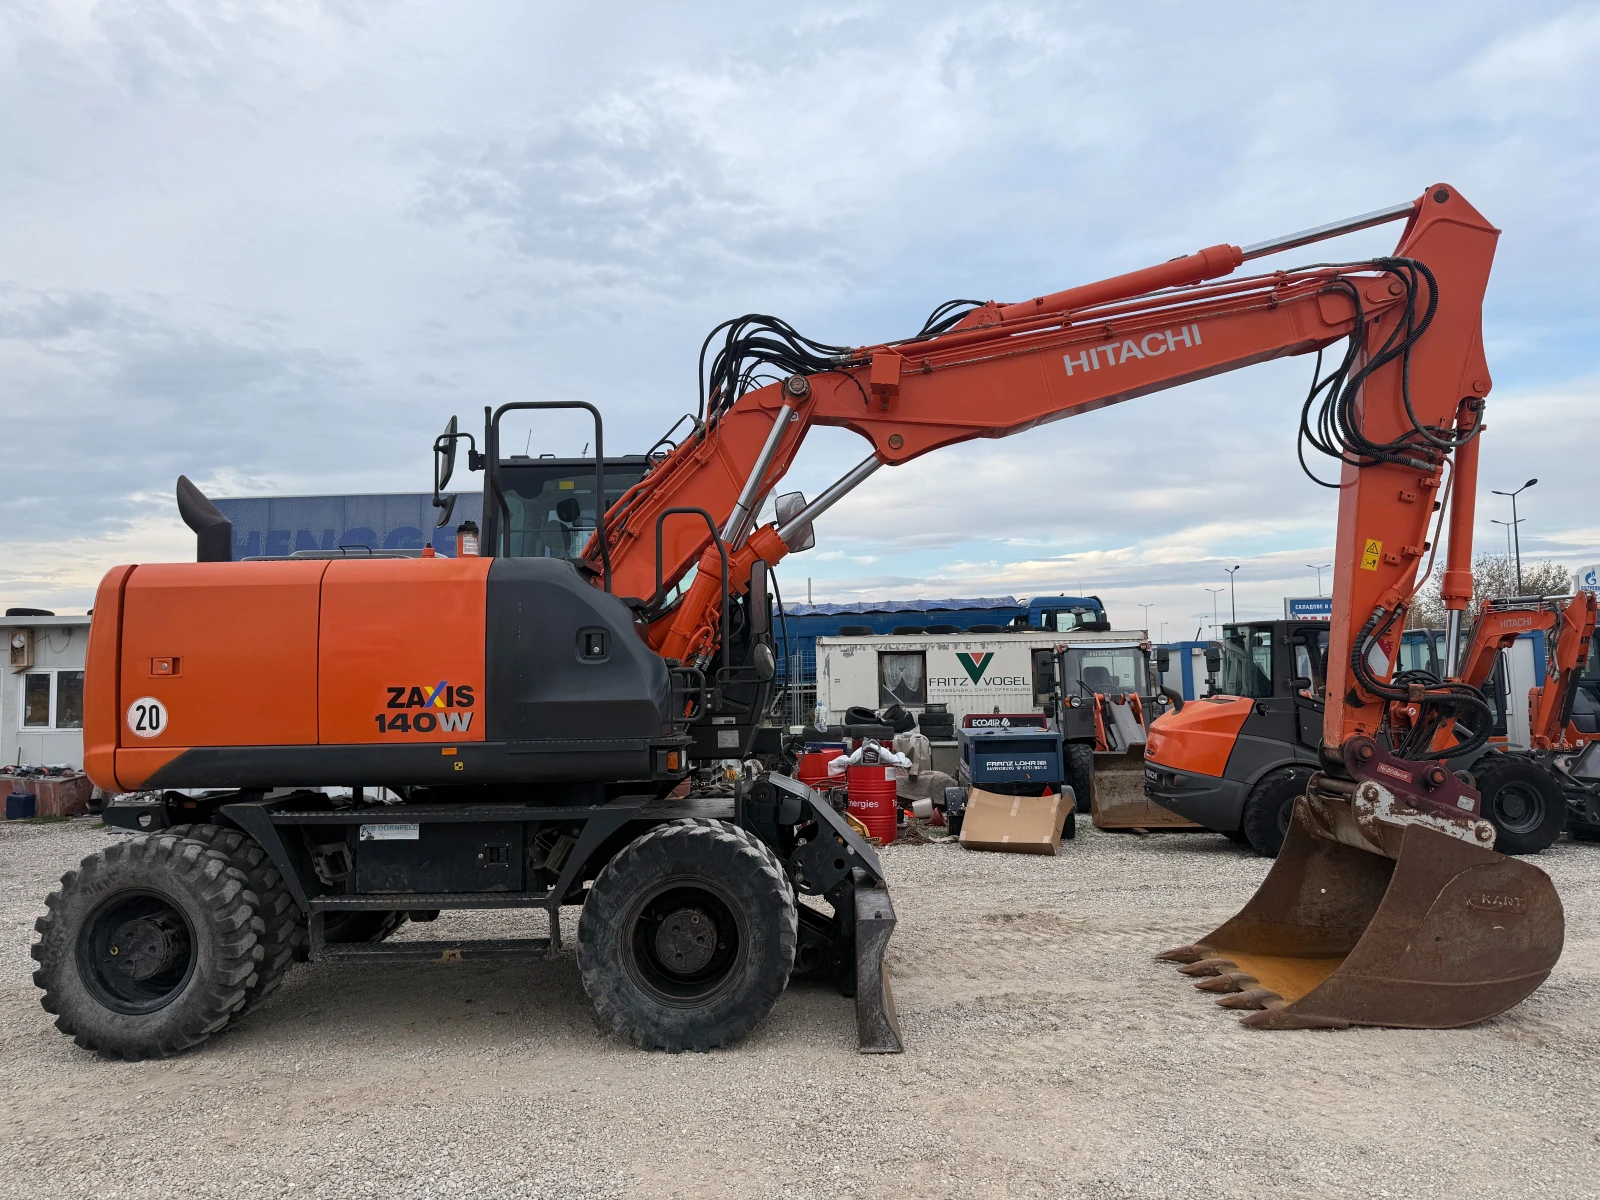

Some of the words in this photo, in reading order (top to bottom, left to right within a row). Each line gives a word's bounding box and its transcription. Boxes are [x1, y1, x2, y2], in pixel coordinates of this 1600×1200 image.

[1063, 323, 1202, 376] HITACHI
[1500, 616, 1532, 629] HITACHI
[929, 677, 968, 686] FRITZ
[983, 676, 1030, 686] VOGEL
[386, 680, 475, 709] ZAXIS
[135, 704, 160, 731] 20
[374, 711, 474, 733] 140W
[972, 718, 1001, 727] ECOAIR
